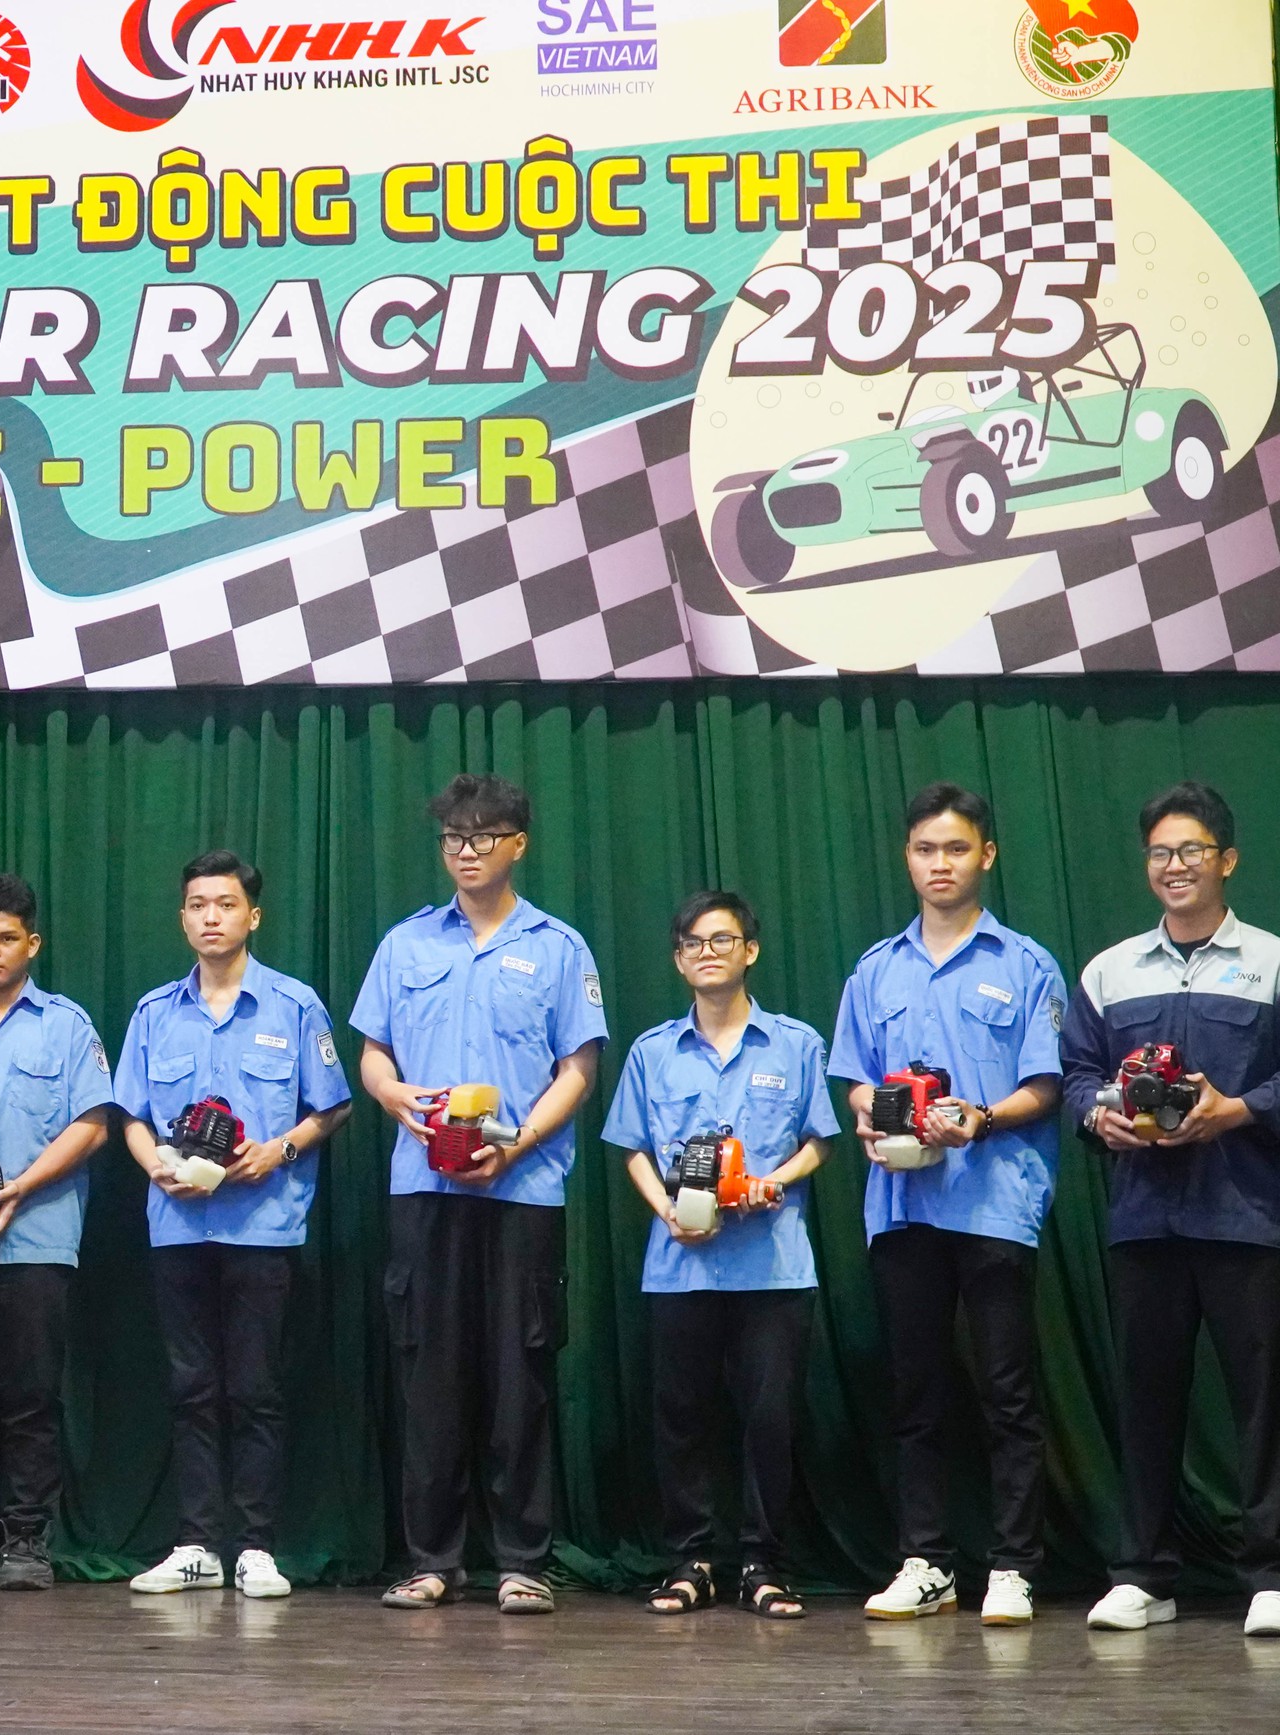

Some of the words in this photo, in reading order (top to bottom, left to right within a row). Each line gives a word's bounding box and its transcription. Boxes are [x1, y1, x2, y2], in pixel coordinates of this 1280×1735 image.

[537, 0, 657, 35] SAE
[539, 44, 657, 69] VIETNAM
[200, 73, 259, 93] NHAT
[264, 71, 307, 91] HUY
[314, 69, 389, 90] KHANG
[395, 67, 443, 87] INTL
[450, 65, 491, 85] JSC
[540, 83, 621, 97] HOCHIMINH
[626, 81, 655, 94] CITY
[733, 85, 937, 114] AGRIBANK
[76, 146, 356, 273] ĐỘNG
[381, 134, 646, 261] CUỘC
[667, 148, 867, 234] THI
[122, 266, 717, 394] RACING
[729, 259, 1098, 377] 2025
[988, 418, 1037, 470] 22
[119, 416, 558, 518] POWER
